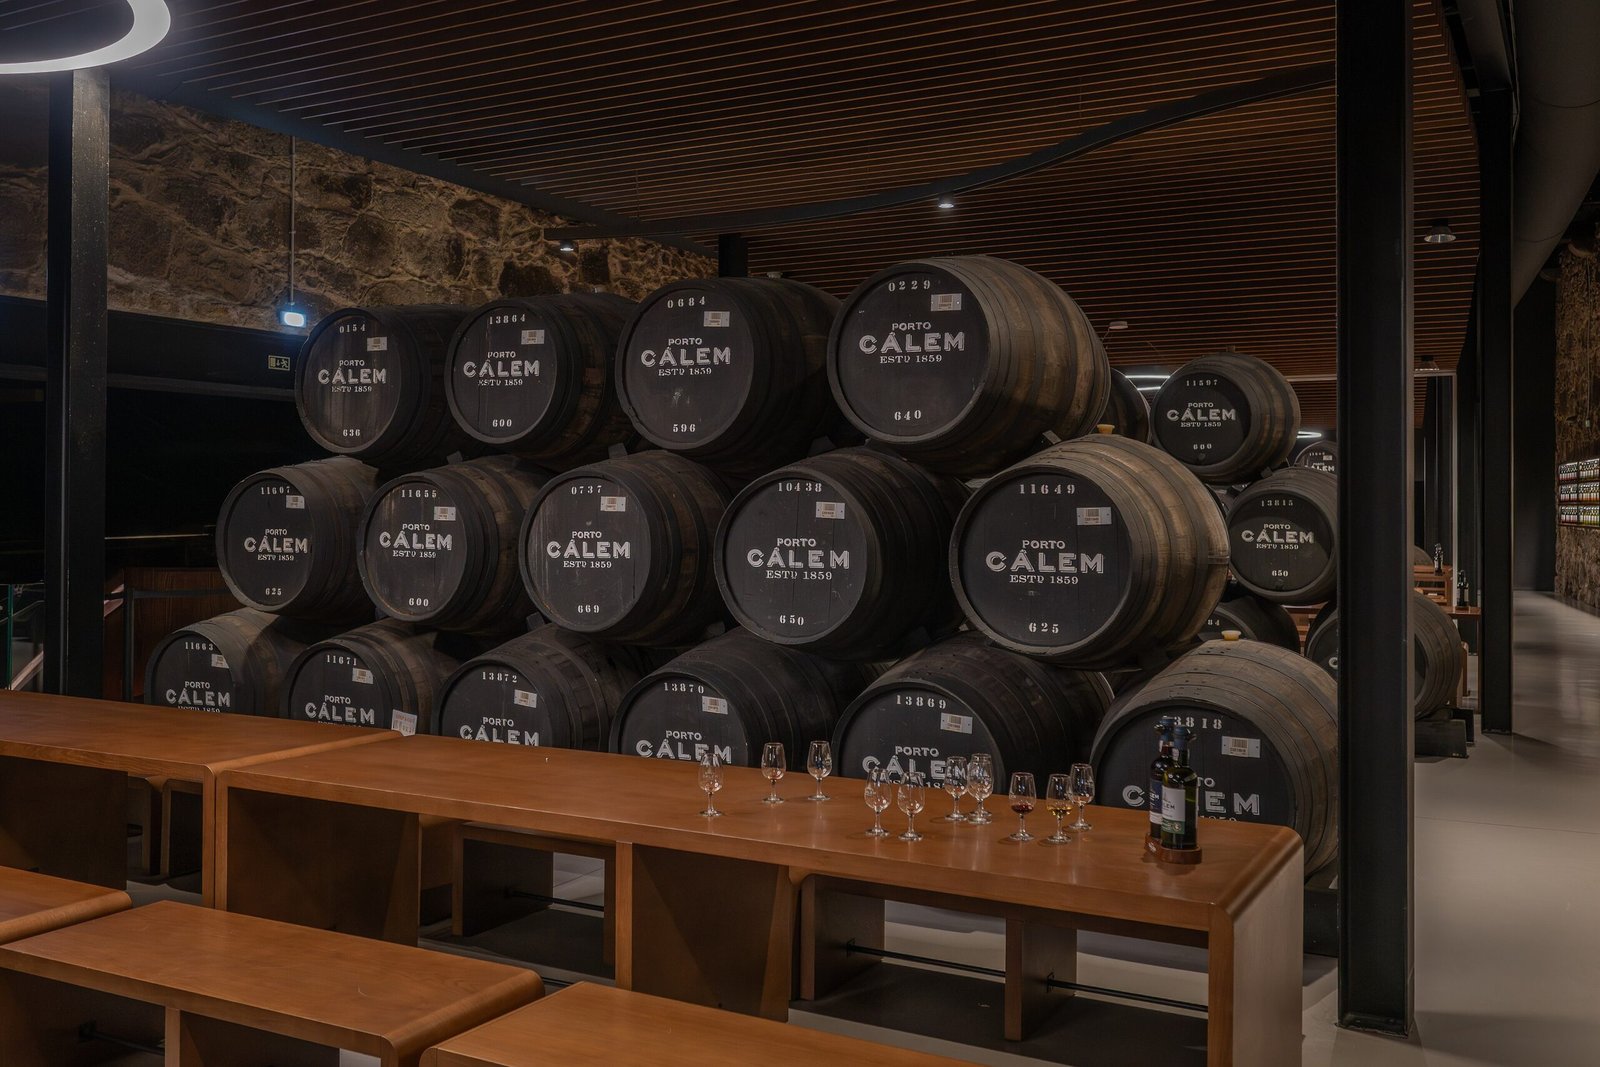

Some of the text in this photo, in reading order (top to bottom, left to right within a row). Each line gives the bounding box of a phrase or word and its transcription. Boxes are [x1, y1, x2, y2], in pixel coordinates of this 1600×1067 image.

[889, 280, 932, 292] 0229
[667, 296, 707, 310] 0684
[489, 314, 527, 325] 13864
[339, 324, 366, 334] 0154
[892, 321, 932, 332] PORTO
[668, 337, 703, 347] PORTO
[859, 331, 965, 354] CÁLEM
[487, 351, 517, 359] PORTO
[641, 346, 731, 368] CÁLEM
[916, 354, 943, 364] 1859
[339, 359, 365, 367] PORTO
[463, 359, 540, 378] CÁLEM
[318, 366, 387, 385] CÁLEM
[689, 367, 712, 376] 1859
[354, 385, 372, 393] 1859
[894, 410, 923, 422] 640
[1167, 408, 1236, 422] CÁLEM
[492, 419, 513, 428] 600
[672, 423, 697, 433] 596
[343, 429, 361, 437] 636
[261, 486, 290, 495] 11607
[571, 485, 602, 495] 0737
[778, 483, 822, 493] 10438
[1019, 484, 1076, 495] 11649
[401, 489, 437, 499] 11655
[402, 524, 430, 532] PORTO
[572, 531, 602, 539] PORTO
[1241, 529, 1314, 544] CÁLEM
[244, 535, 309, 554] CÁLEM
[379, 531, 452, 551] CÁLEM
[777, 537, 817, 548] PORTO
[1022, 540, 1066, 550] PORTO
[546, 539, 631, 559] CÁLEM
[419, 551, 437, 559] 1859
[747, 547, 850, 570] CÁLEM
[590, 561, 612, 569] 1859
[986, 549, 1104, 574] CÁLEM
[803, 570, 833, 580] 1859
[1050, 576, 1079, 585] 1859
[265, 587, 282, 596] 625
[409, 598, 429, 607] 600
[577, 603, 600, 614] 669
[780, 615, 805, 626] 650
[1028, 623, 1060, 634] 625
[326, 655, 357, 666] 11671
[482, 672, 519, 683] 13872
[185, 681, 211, 689] PORTO
[664, 682, 705, 694] 13870
[166, 688, 231, 707] CÁLEM
[325, 694, 352, 705] PORTO
[896, 694, 947, 710] 13869
[305, 702, 375, 725] CÁLEM
[482, 717, 514, 727] PORTO
[1173, 716, 1223, 730] 3818
[460, 724, 540, 747] CÁLEM
[665, 730, 703, 741] PORTO
[636, 739, 732, 764] CÁLEM
[895, 746, 940, 758] PORTO
[1122, 785, 1261, 816] CEM
